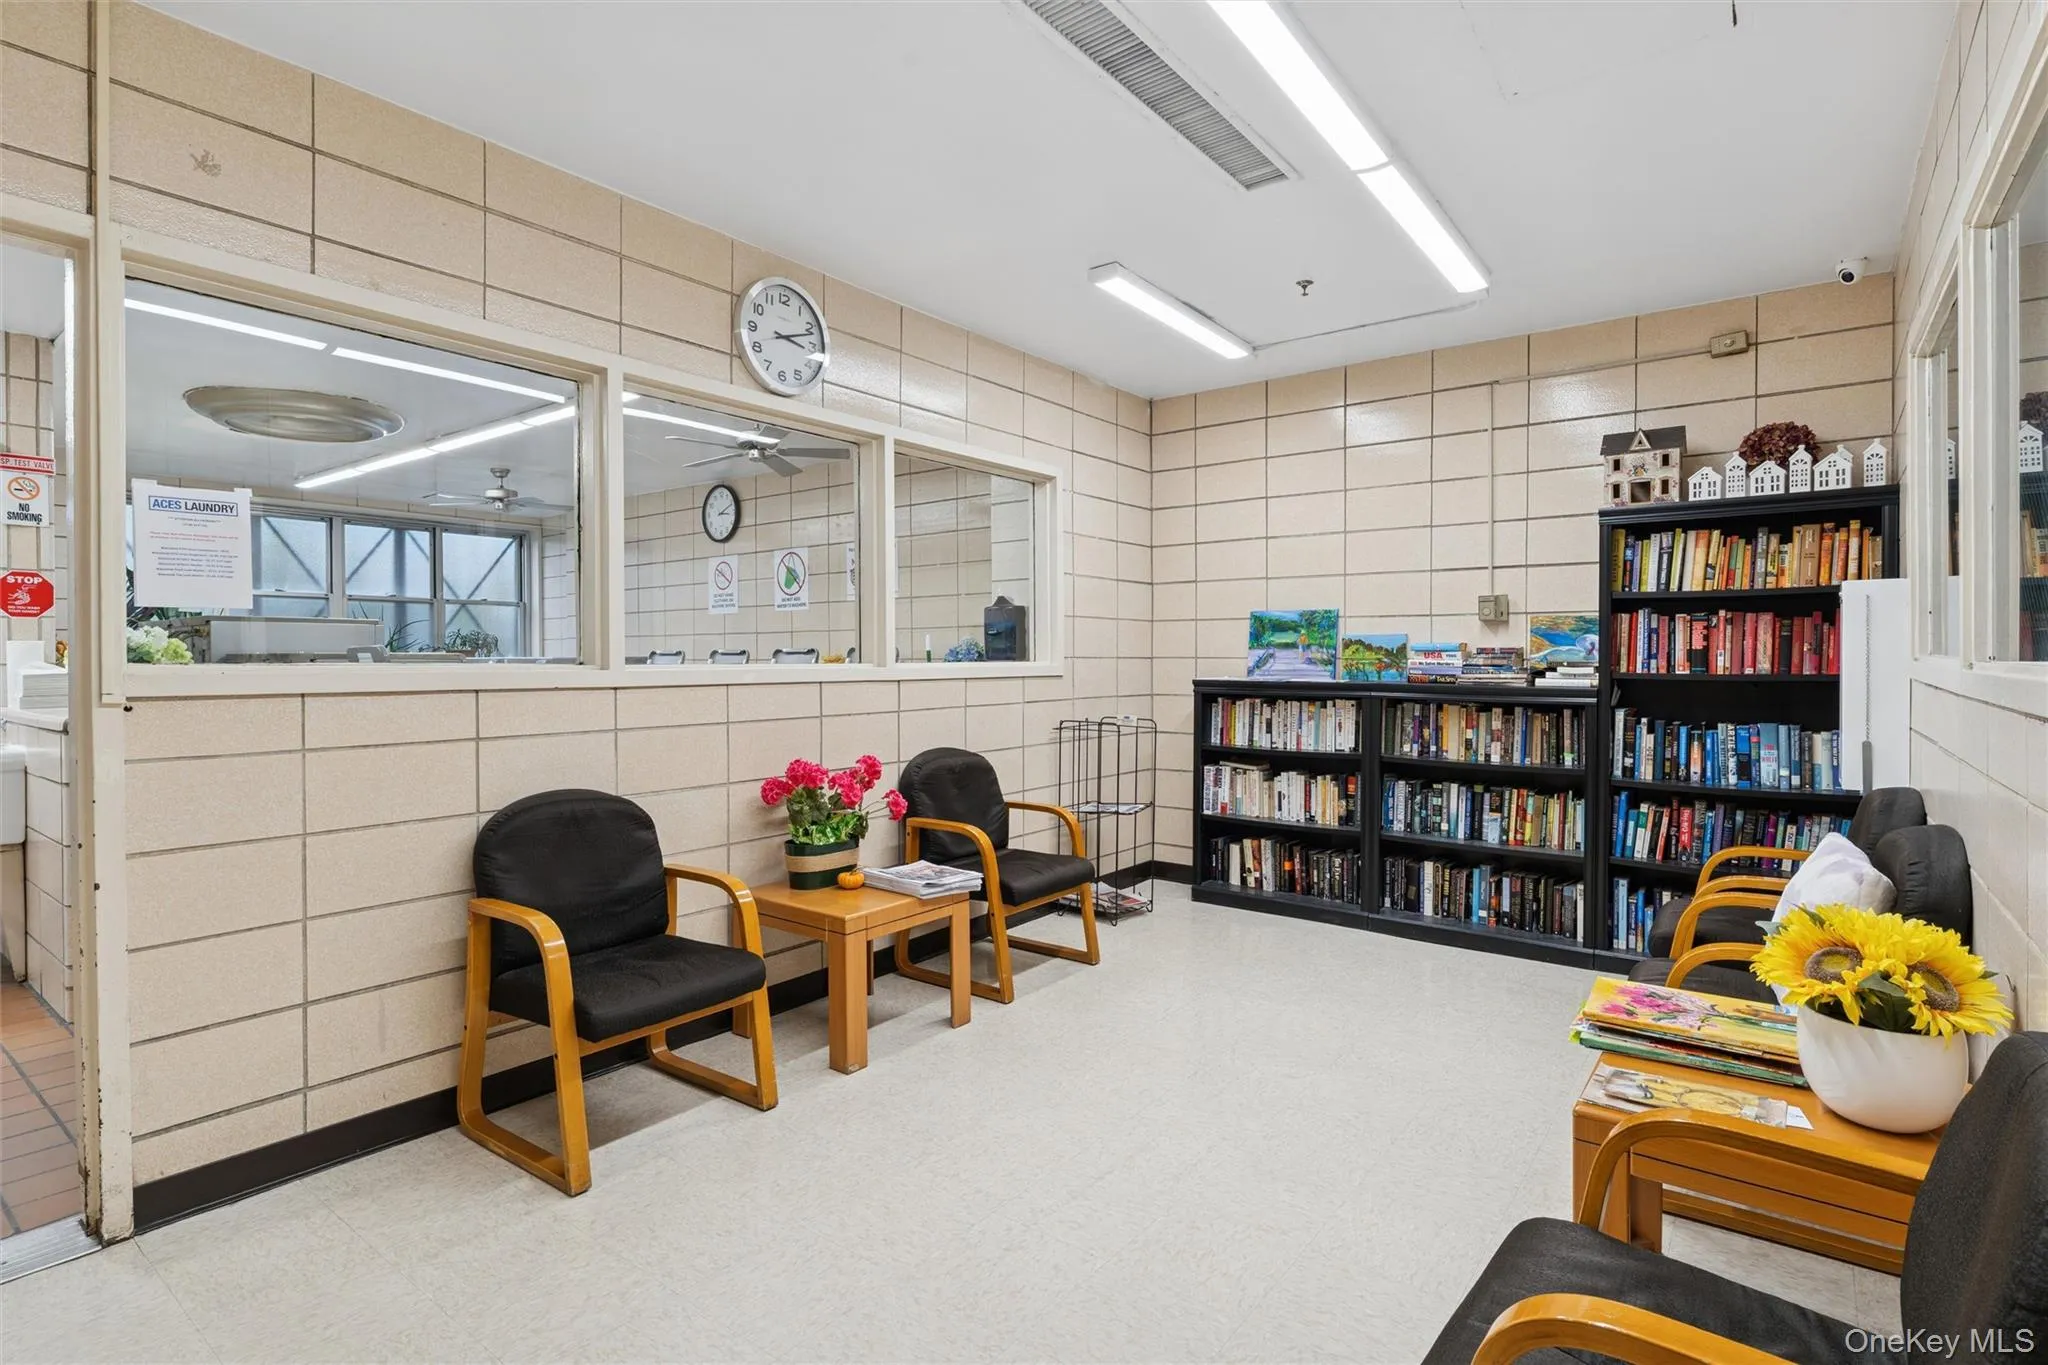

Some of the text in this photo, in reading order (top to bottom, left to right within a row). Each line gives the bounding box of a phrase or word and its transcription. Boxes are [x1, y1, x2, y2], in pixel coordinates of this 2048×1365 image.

[766, 292, 774, 306] 11
[778, 292, 791, 307] 12
[753, 302, 764, 316] 10
[798, 305, 802, 317] 1
[747, 320, 758, 332] 9
[805, 321, 815, 335] 2
[752, 341, 762, 353] 8
[808, 341, 817, 354] 3
[763, 359, 772, 371] 7
[777, 370, 787, 382] 6
[793, 369, 803, 381] 5
[18, 503, 30, 512] NO
[152, 498, 235, 513] ACES LAUNDRY
[7, 511, 42, 523] SMOKING
[6, 575, 43, 584] STOP
[1423, 651, 1443, 659] USA
